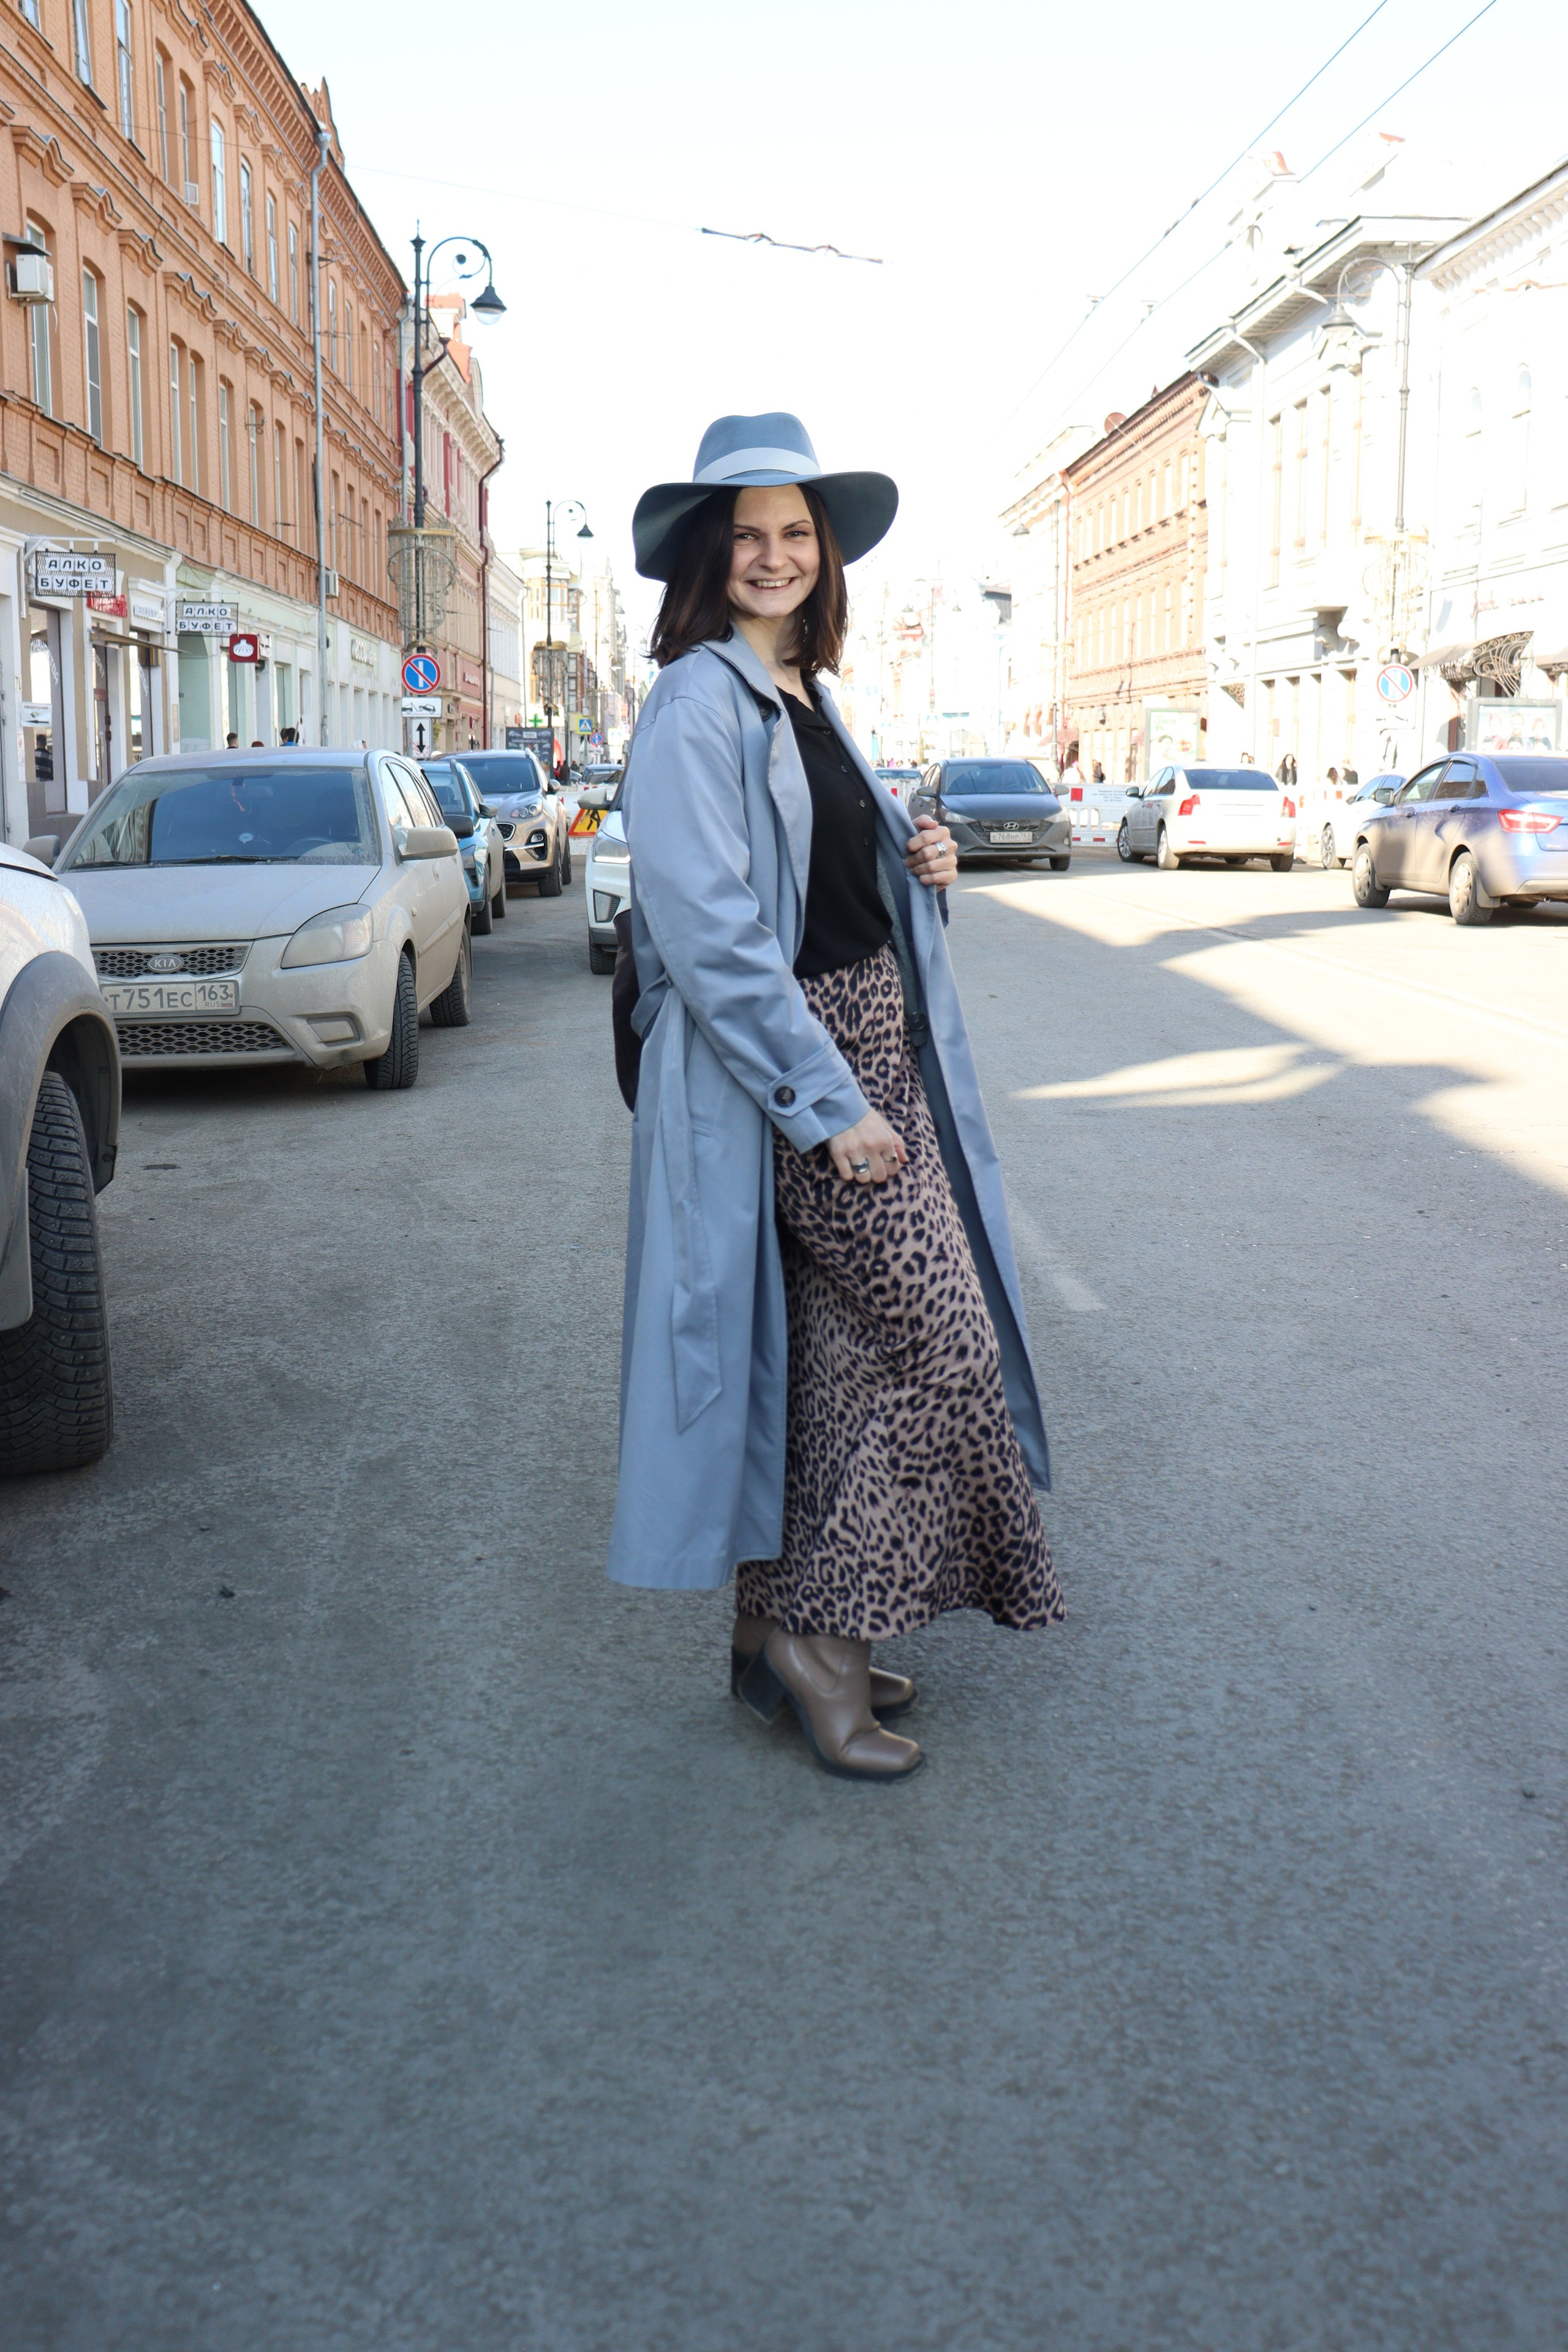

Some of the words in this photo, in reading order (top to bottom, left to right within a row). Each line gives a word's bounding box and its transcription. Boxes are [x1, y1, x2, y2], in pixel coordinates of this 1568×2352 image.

[48, 559, 102, 570] АЛКО
[40, 578, 108, 589] БУФЕТ
[185, 607, 227, 616] АЛКО
[179, 621, 233, 631] БУФЕТ
[154, 958, 176, 968] KIA
[109, 987, 193, 1011] Т751ЕС
[197, 984, 229, 1001] 163
